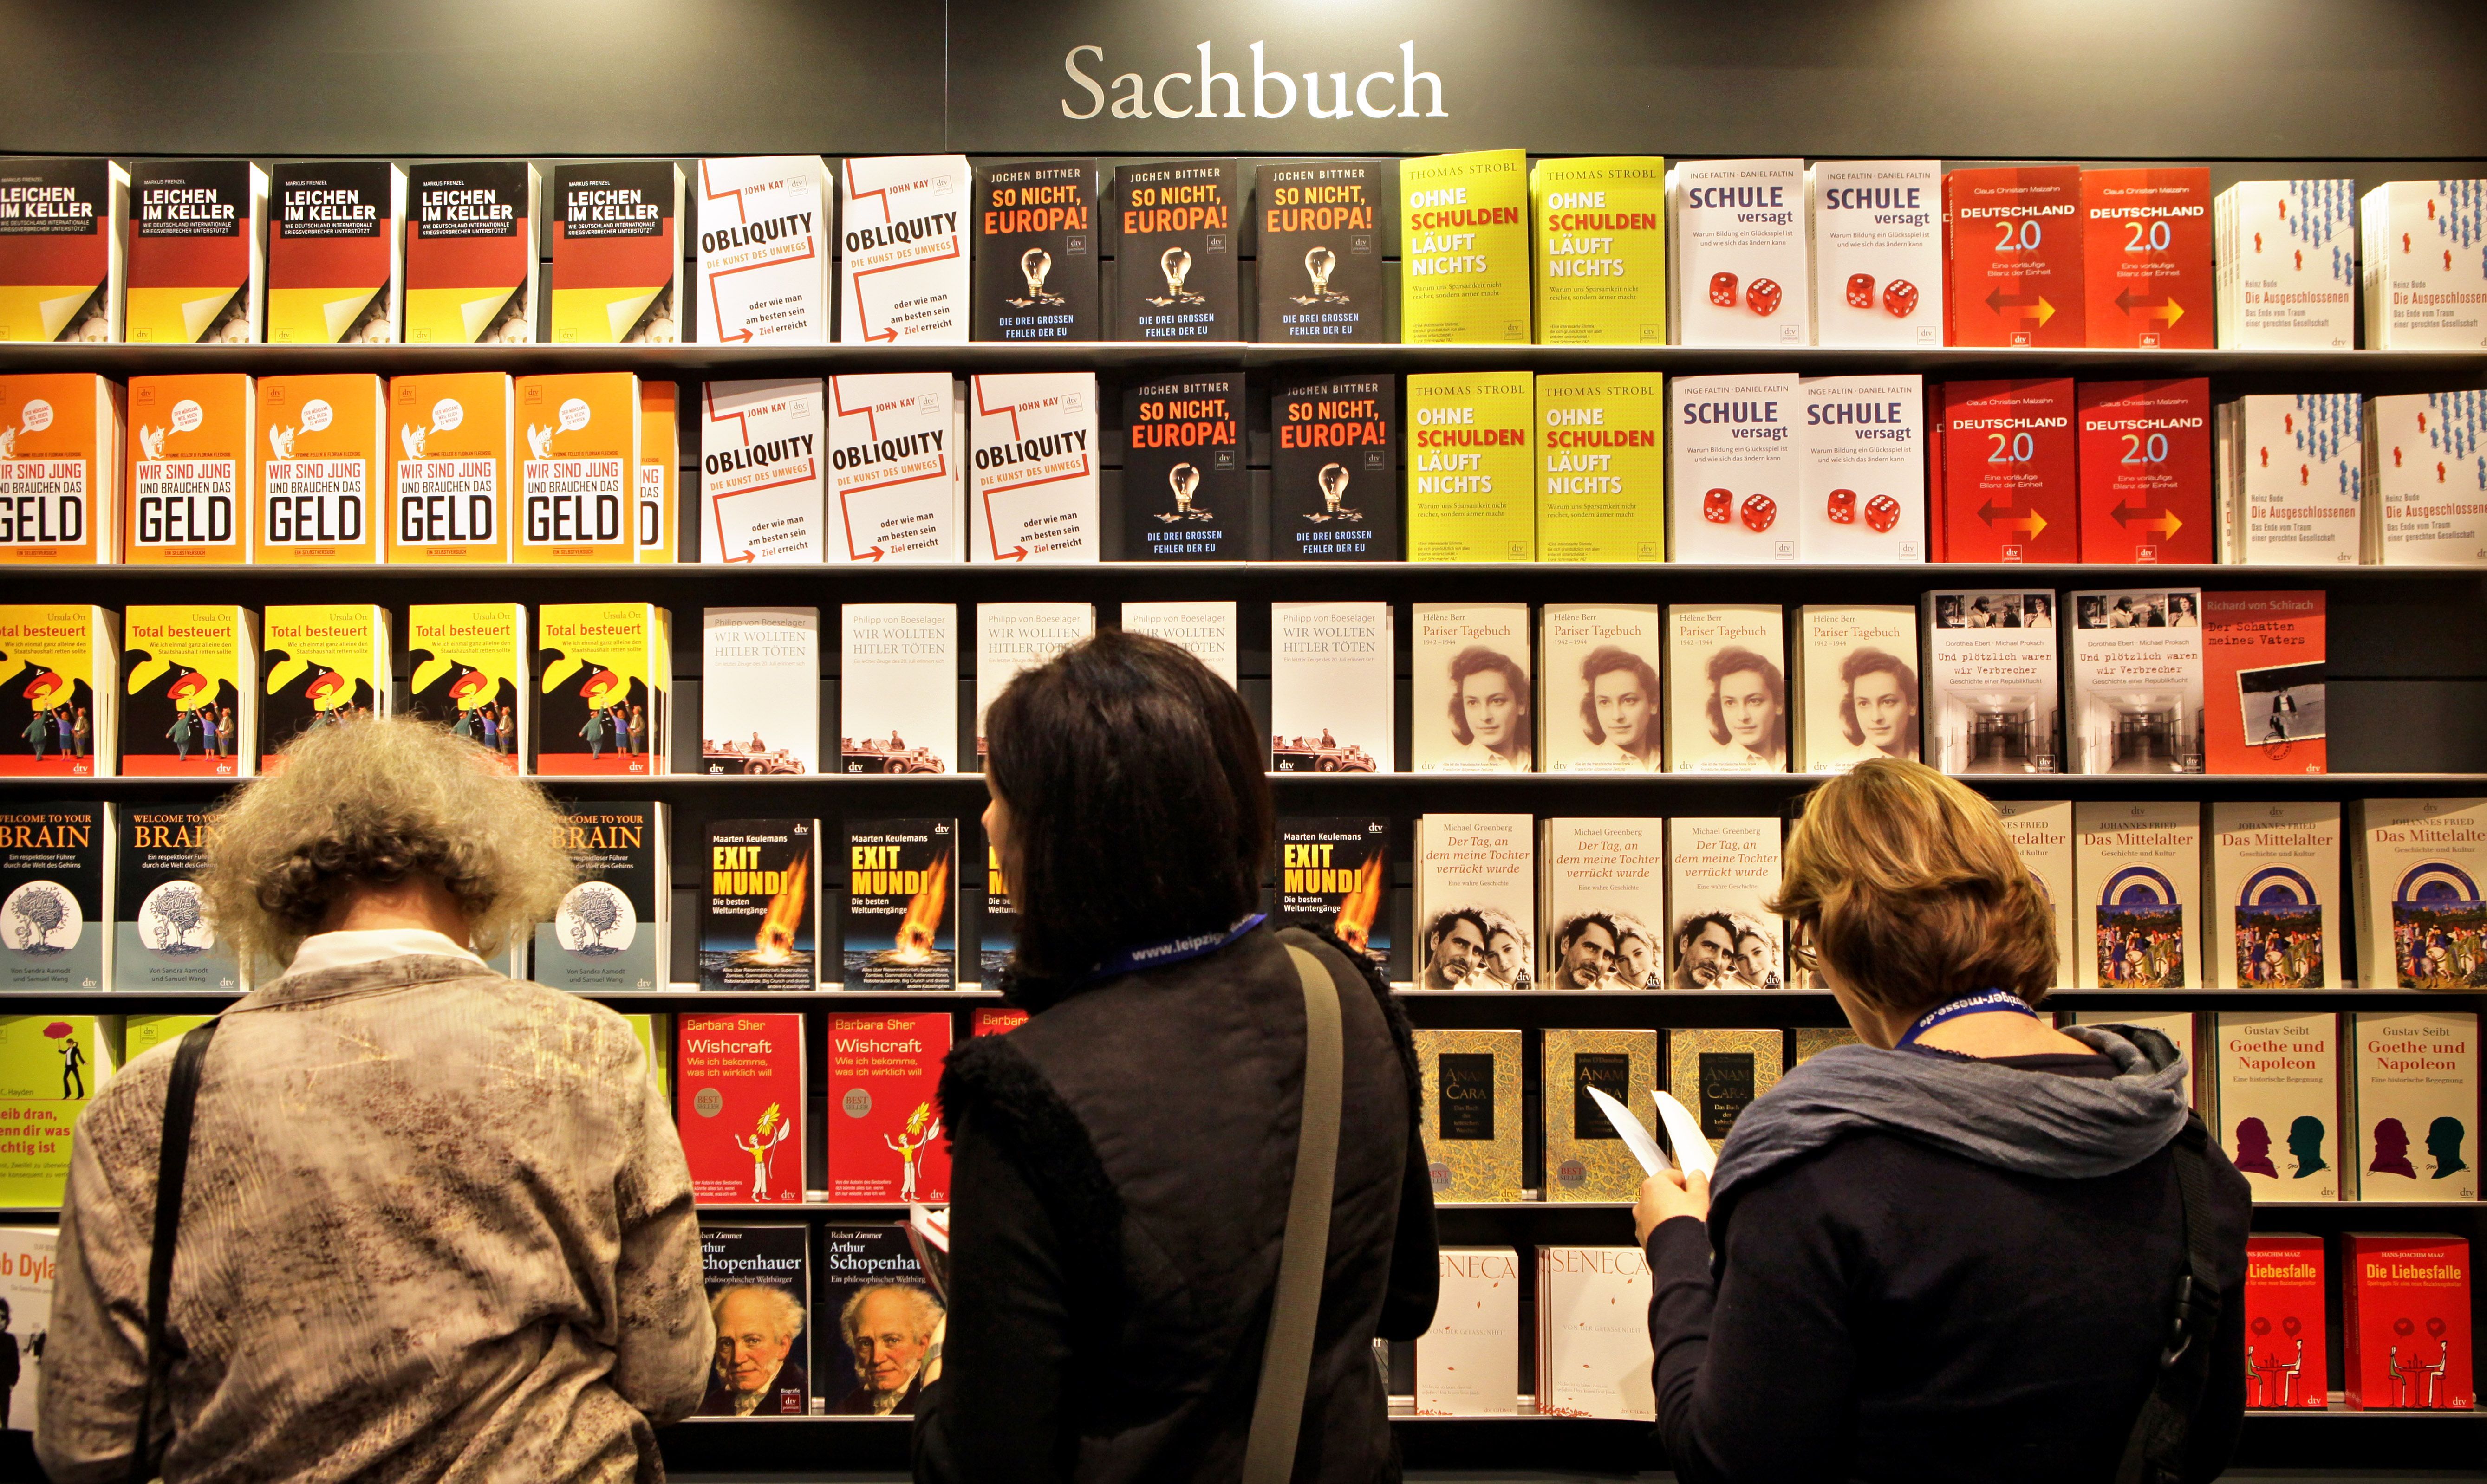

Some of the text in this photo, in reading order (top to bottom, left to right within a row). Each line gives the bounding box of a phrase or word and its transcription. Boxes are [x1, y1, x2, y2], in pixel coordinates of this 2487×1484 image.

[1061, 40, 1449, 119] Sachbuch
[991, 169, 1080, 182] JOCHEN BITTNER
[1409, 163, 1517, 180] THOMAS STROBL
[890, 180, 928, 194] JOHN KAY
[285, 189, 358, 206] LEICHEN
[993, 186, 1080, 207] SO NICHT,
[1410, 187, 1467, 209] OHNE
[1827, 188, 1919, 209] SCHULE
[285, 205, 376, 221] IM KELLER
[1411, 207, 1518, 230] SCHULDEN
[984, 207, 1088, 234] EUROPA!
[1875, 213, 1929, 227] versagt
[846, 212, 957, 253] OBLIQUITY
[1411, 232, 1475, 254] LÄUFT
[851, 241, 951, 268] DIE KUNST DES UMWEGS
[1413, 255, 1487, 276] NICHTS
[2246, 292, 2349, 305] Die Ausgeschlossenen
[1000, 315, 1073, 326] DIE DREI GROSSEN
[1006, 329, 1035, 338] FEHLER
[1039, 328, 1054, 337] DER
[1954, 418, 2067, 429] DEUTSCHLAND
[1988, 433, 2034, 462] 2.0
[401, 462, 491, 479] WIR SIND JUNG
[402, 481, 491, 493] UND BRAUCHEN DAS
[402, 495, 492, 541] GELD
[2208, 601, 2245, 610] Richard
[2269, 600, 2313, 610] Schirach
[1284, 615, 1311, 623] Philipp
[1331, 614, 1374, 623] Boeselager
[546, 624, 641, 635] Total besteuert
[1284, 628, 1374, 637] WIR WOLLTEN
[1424, 625, 1510, 639] Pariser Tagebuch
[2208, 622, 2295, 632] Der Schatten
[1284, 641, 1375, 652] HITLER TÖTEN
[2209, 635, 2305, 645] meines Vaters
[1962, 653, 2017, 662] plötzlich
[935, 823, 949, 832] dtv
[1474, 824, 1512, 832] Greenberg
[0, 825, 91, 848] BRAIN
[1448, 837, 1468, 846] Der
[1471, 837, 1491, 848] Tag,
[2084, 833, 2193, 845] Das Mittelalter
[852, 846, 901, 869] EXIT
[1426, 850, 1530, 859] dem meine Tochter
[1437, 864, 1519, 873] verrückt wurde
[852, 871, 928, 895] MUNDI
[851, 906, 908, 914] Weltuntergänge
[835, 1019, 915, 1030] Barbara Sher
[2245, 1026, 2309, 1035] Gustav Seibt
[835, 1039, 922, 1052] Wishcraft
[2230, 1040, 2324, 1052] Goethe und
[2240, 1057, 2315, 1072] Napoleon
[1, 1108, 57, 1121] eib dran,
[0, 1124, 71, 1136] enn dir was
[0, 1141, 55, 1156] chtig ist
[830, 1242, 865, 1252] Arthur
[20, 1254, 55, 1284] Dyla
[702, 1254, 802, 1274] chopenhauer
[1552, 1250, 1650, 1276] SENECA
[2367, 1264, 2461, 1279] Die Liebesfalle
